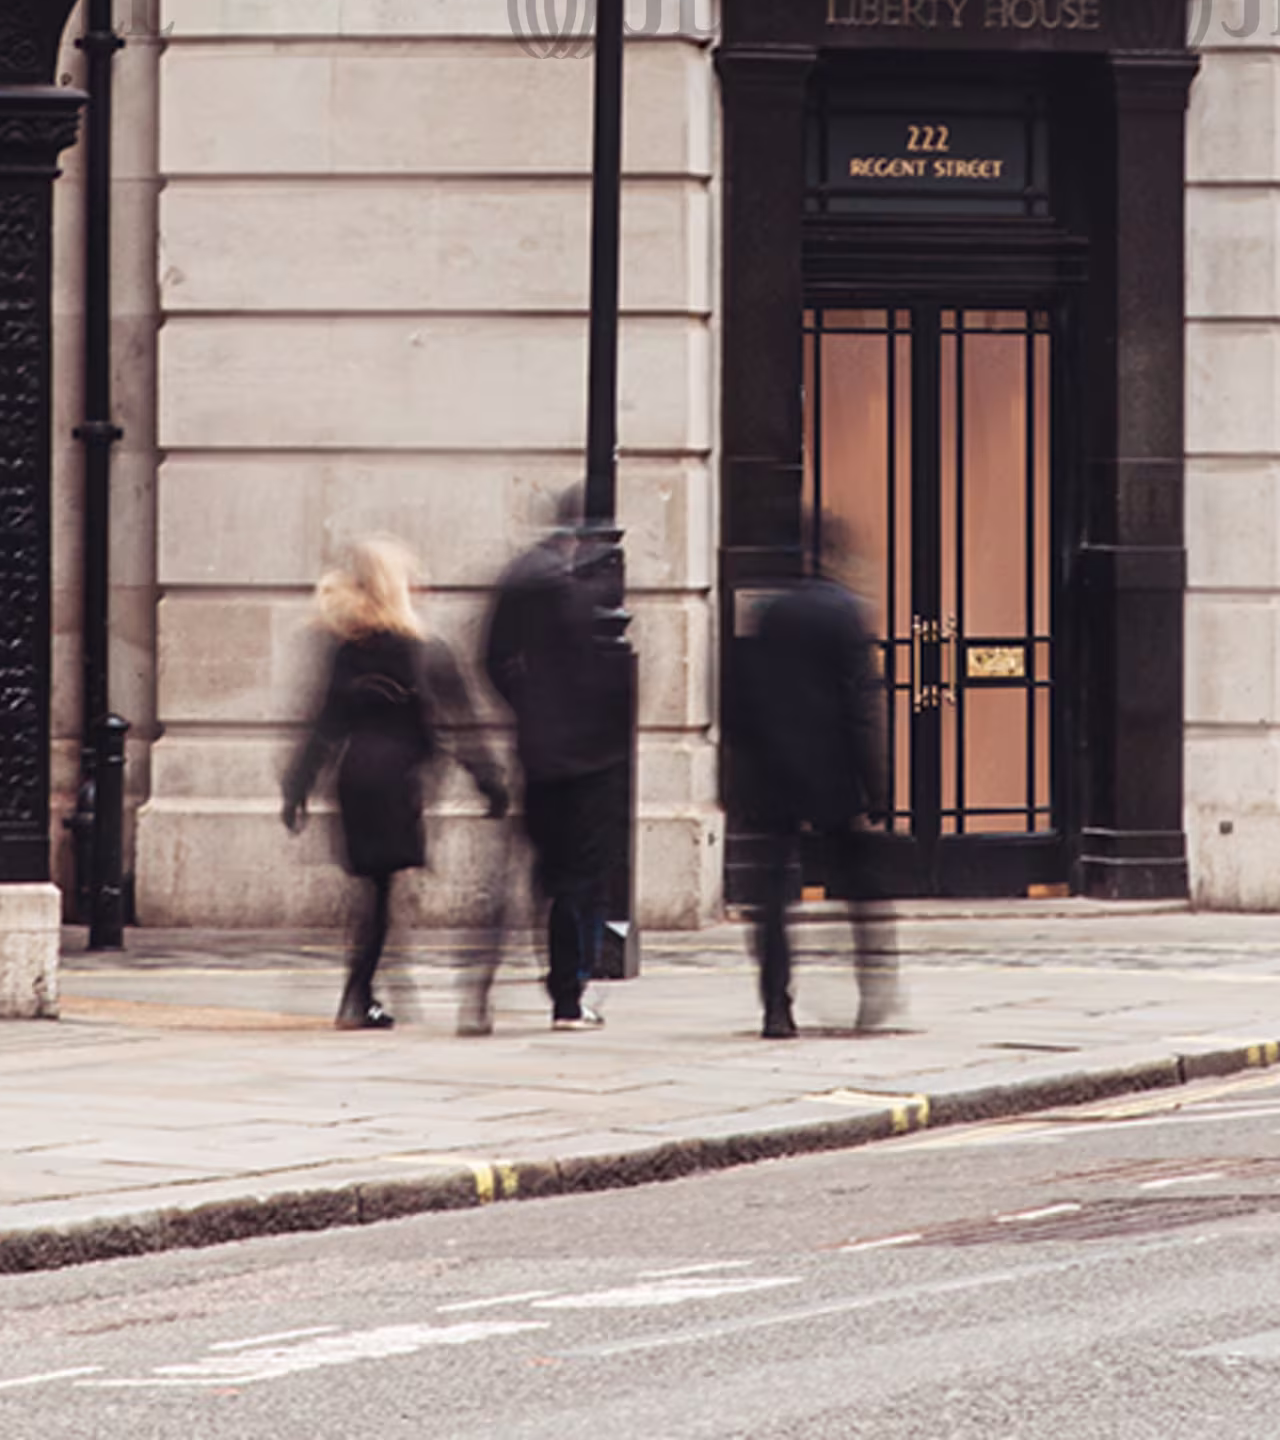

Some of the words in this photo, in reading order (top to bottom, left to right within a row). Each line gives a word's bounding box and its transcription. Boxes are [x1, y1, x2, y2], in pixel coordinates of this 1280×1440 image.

[907, 125, 950, 152] 222
[850, 159, 926, 177] REGENT
[933, 159, 1003, 178] STREET
